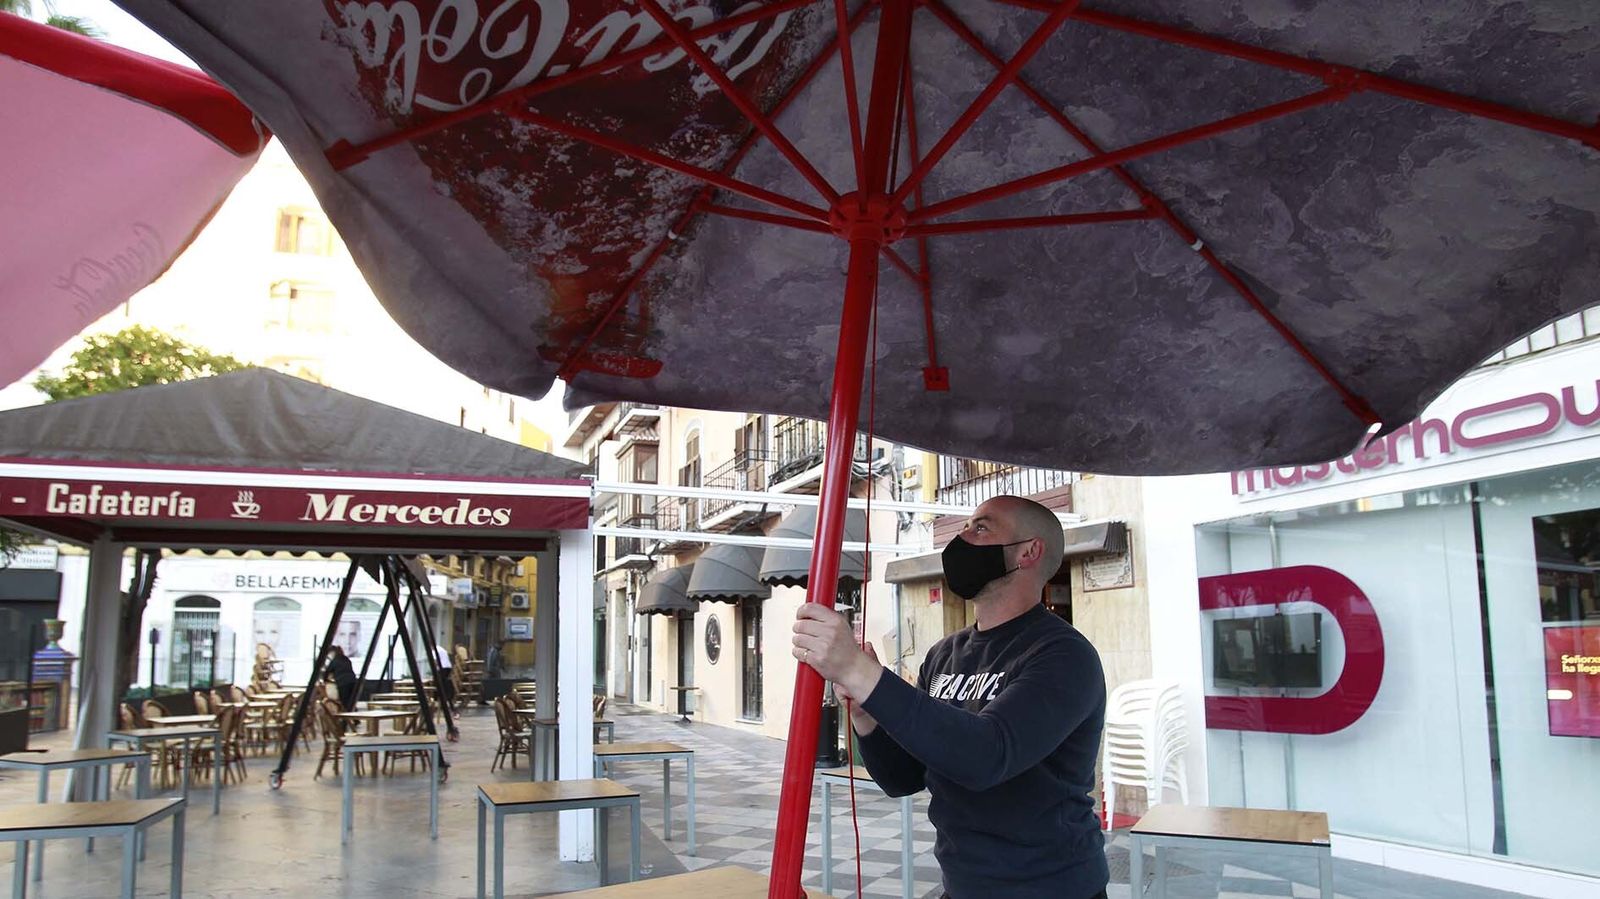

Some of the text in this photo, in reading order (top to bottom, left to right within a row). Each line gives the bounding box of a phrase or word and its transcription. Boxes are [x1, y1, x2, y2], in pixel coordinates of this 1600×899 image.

[47, 483, 196, 517] Cafetería
[298, 493, 512, 526] Mercedes
[1562, 664, 1576, 673] ha
